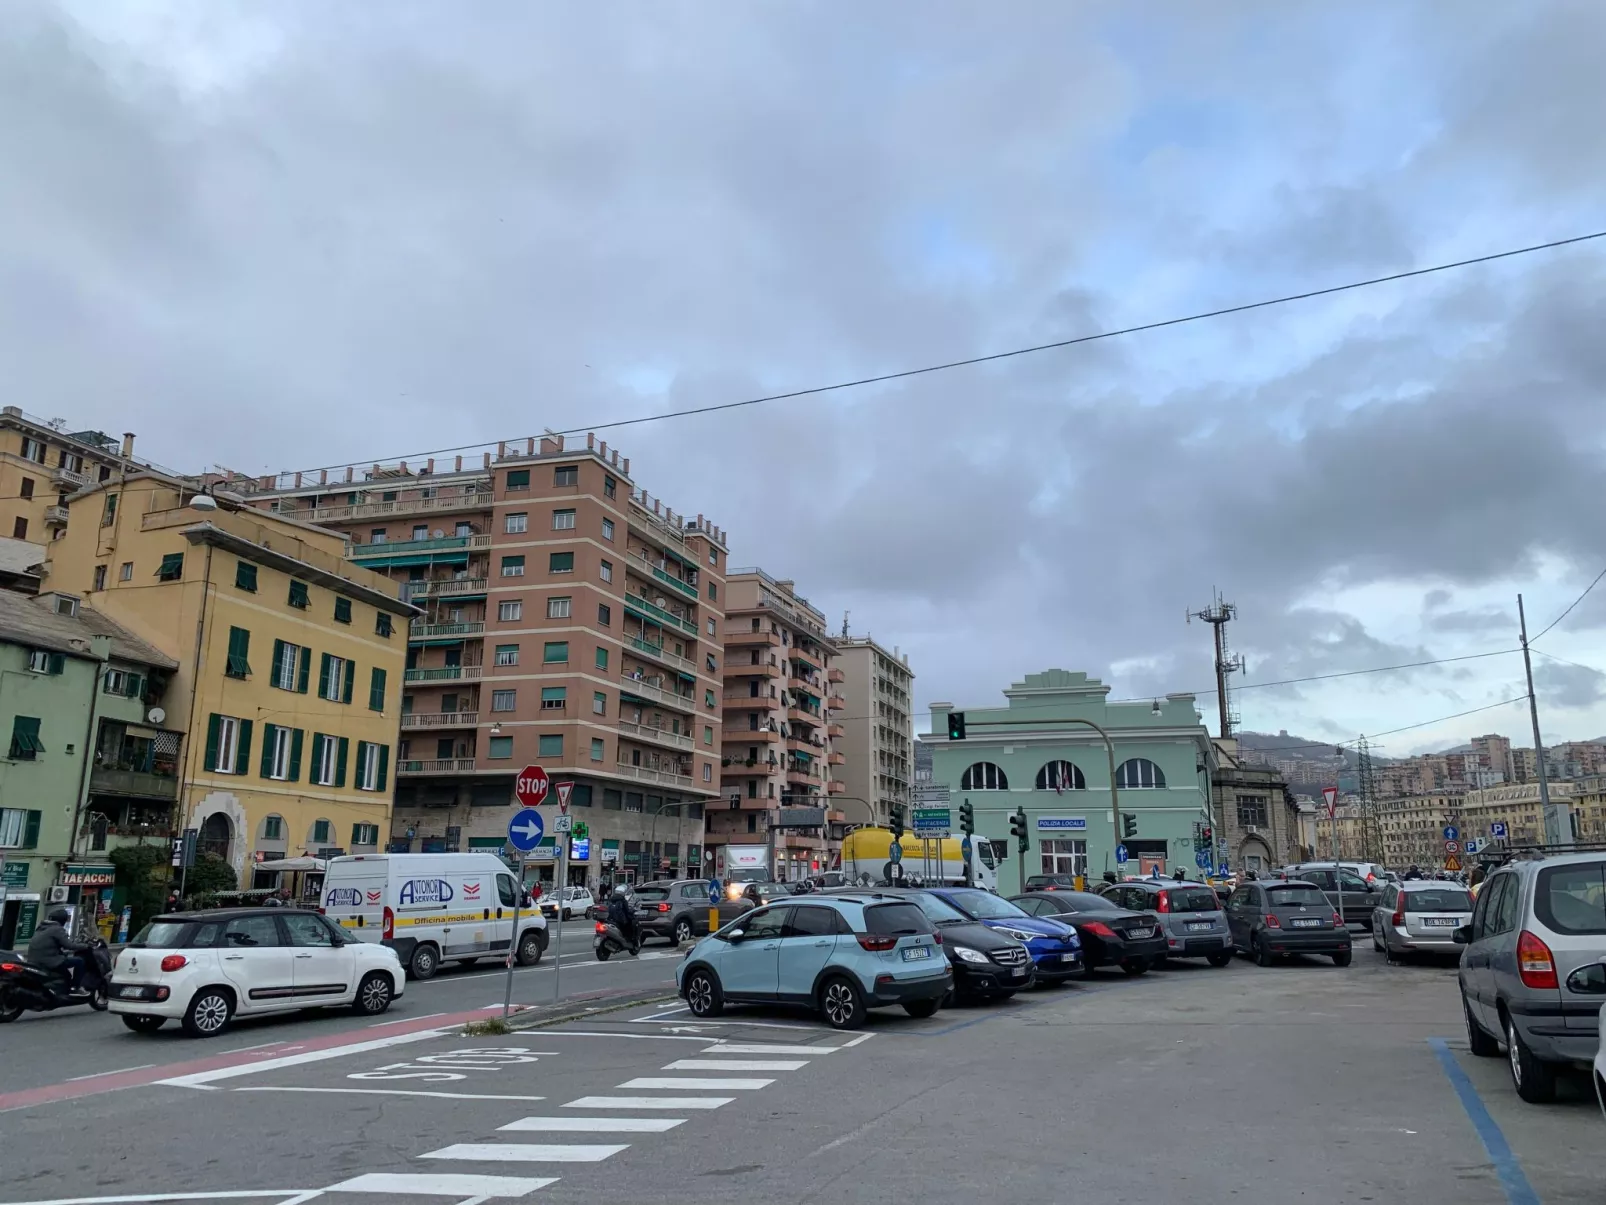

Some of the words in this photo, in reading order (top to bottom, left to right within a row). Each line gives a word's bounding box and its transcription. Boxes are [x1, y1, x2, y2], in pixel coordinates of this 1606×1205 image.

[518, 778, 547, 794] STOP
[1494, 824, 1503, 835] P
[554, 847, 561, 855] P
[1447, 843, 1456, 851] 30
[1467, 843, 1475, 851] P
[414, 895, 439, 903] SERVICE
[414, 916, 446, 925] Officina
[448, 914, 475, 922] mobile
[346, 1047, 560, 1082] STOP
